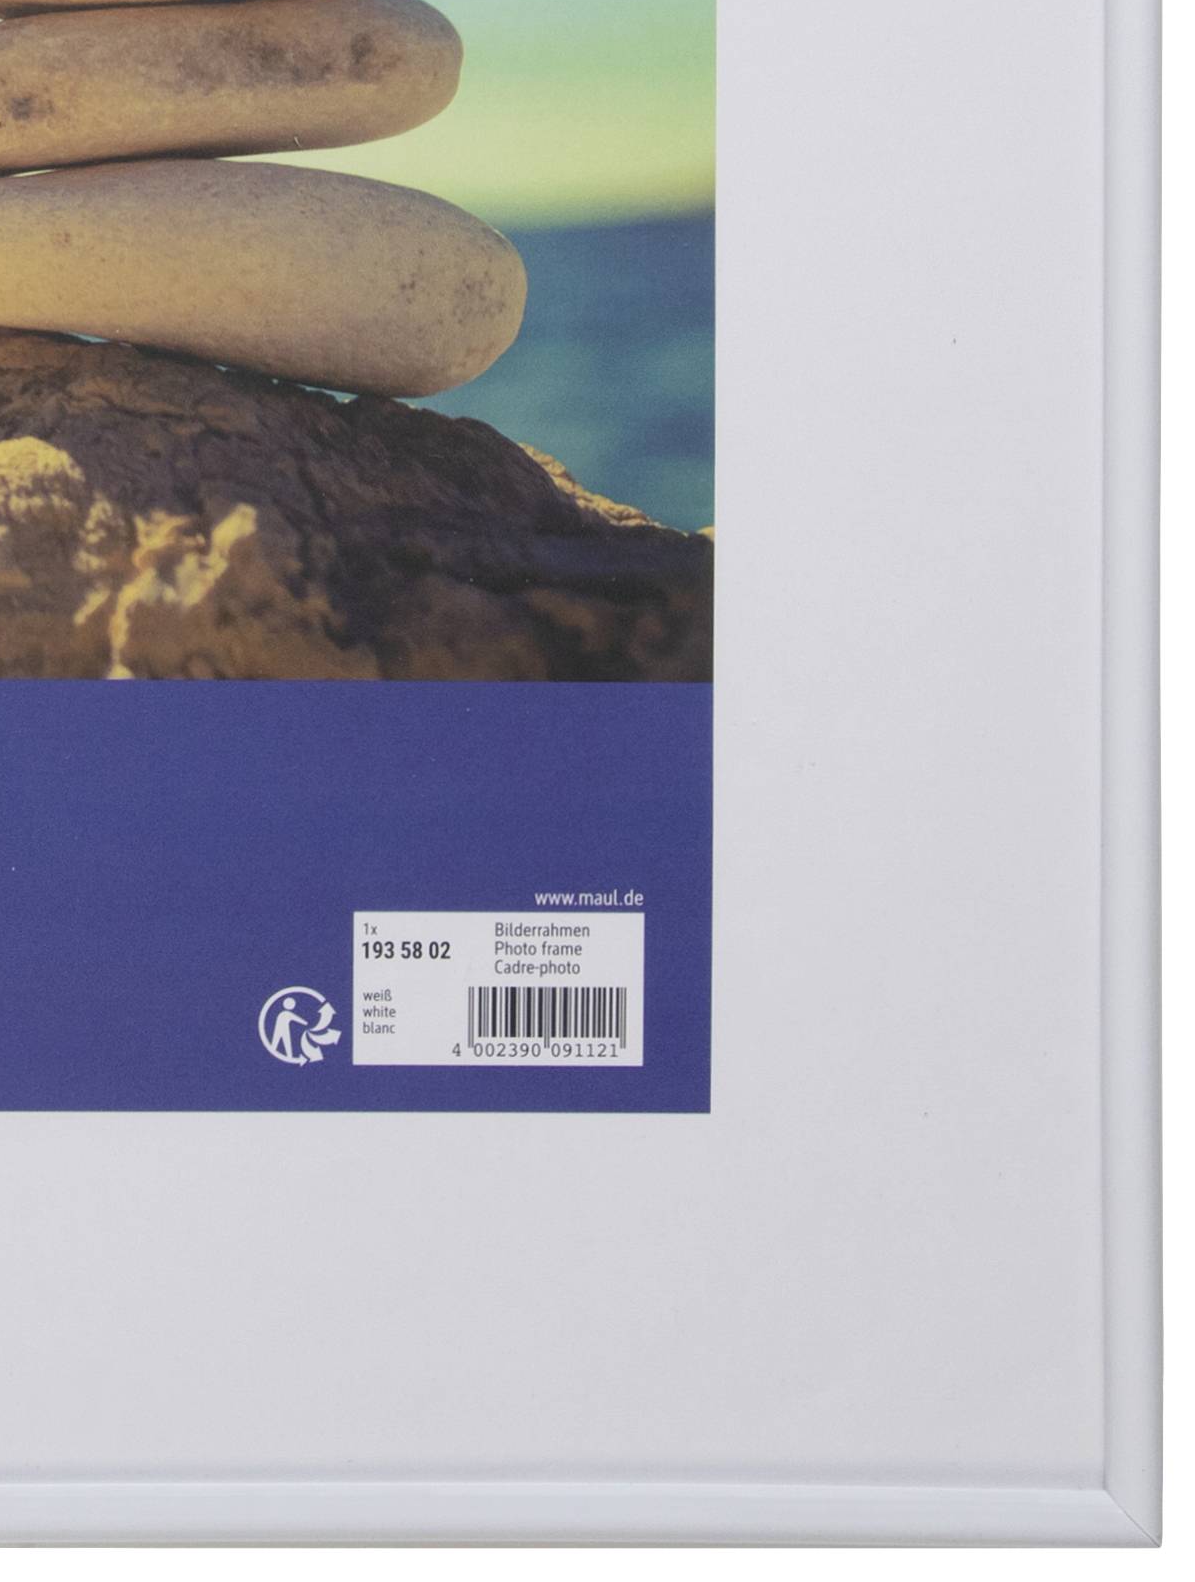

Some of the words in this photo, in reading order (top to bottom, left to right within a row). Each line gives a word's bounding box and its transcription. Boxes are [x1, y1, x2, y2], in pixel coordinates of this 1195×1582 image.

[534, 890, 645, 907] www.maul.de
[362, 923, 378, 936] 1x
[494, 922, 591, 938] Bilderrahmen
[361, 941, 396, 960] 193
[400, 941, 424, 960] 58
[427, 941, 452, 960] 02
[494, 941, 538, 956] Photo
[541, 941, 583, 956] frame
[494, 960, 581, 976] Cadre-photo
[362, 990, 393, 1002] weiß
[362, 1006, 397, 1018] white
[362, 1022, 396, 1035] blanc
[451, 1042, 462, 1057] 4
[473, 1042, 542, 1058] 002390
[550, 1042, 619, 1058] 091121
